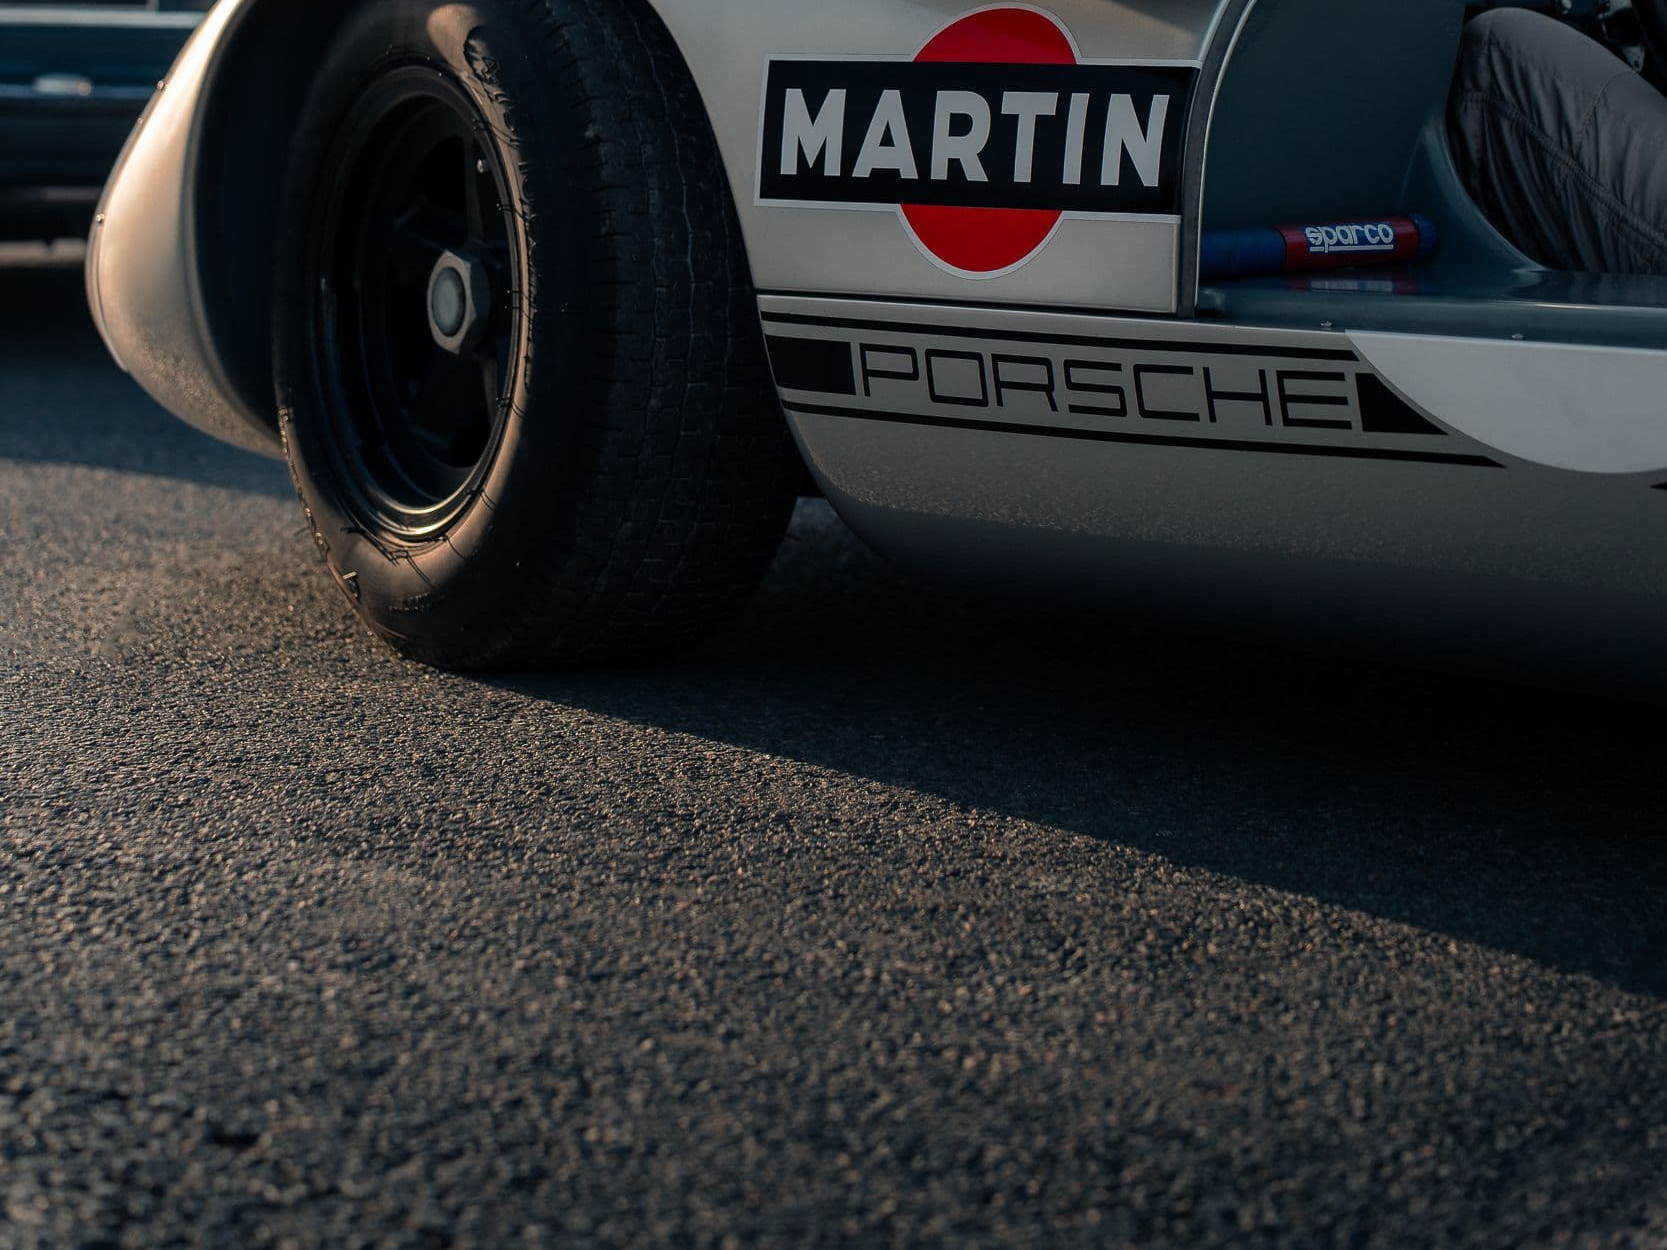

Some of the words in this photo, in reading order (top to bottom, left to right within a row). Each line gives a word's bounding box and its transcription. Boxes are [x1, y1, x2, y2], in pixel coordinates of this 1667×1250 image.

[780, 88, 1169, 187] MARTIN
[1305, 223, 1394, 254] sparco
[859, 343, 1353, 431] PORSCHE
